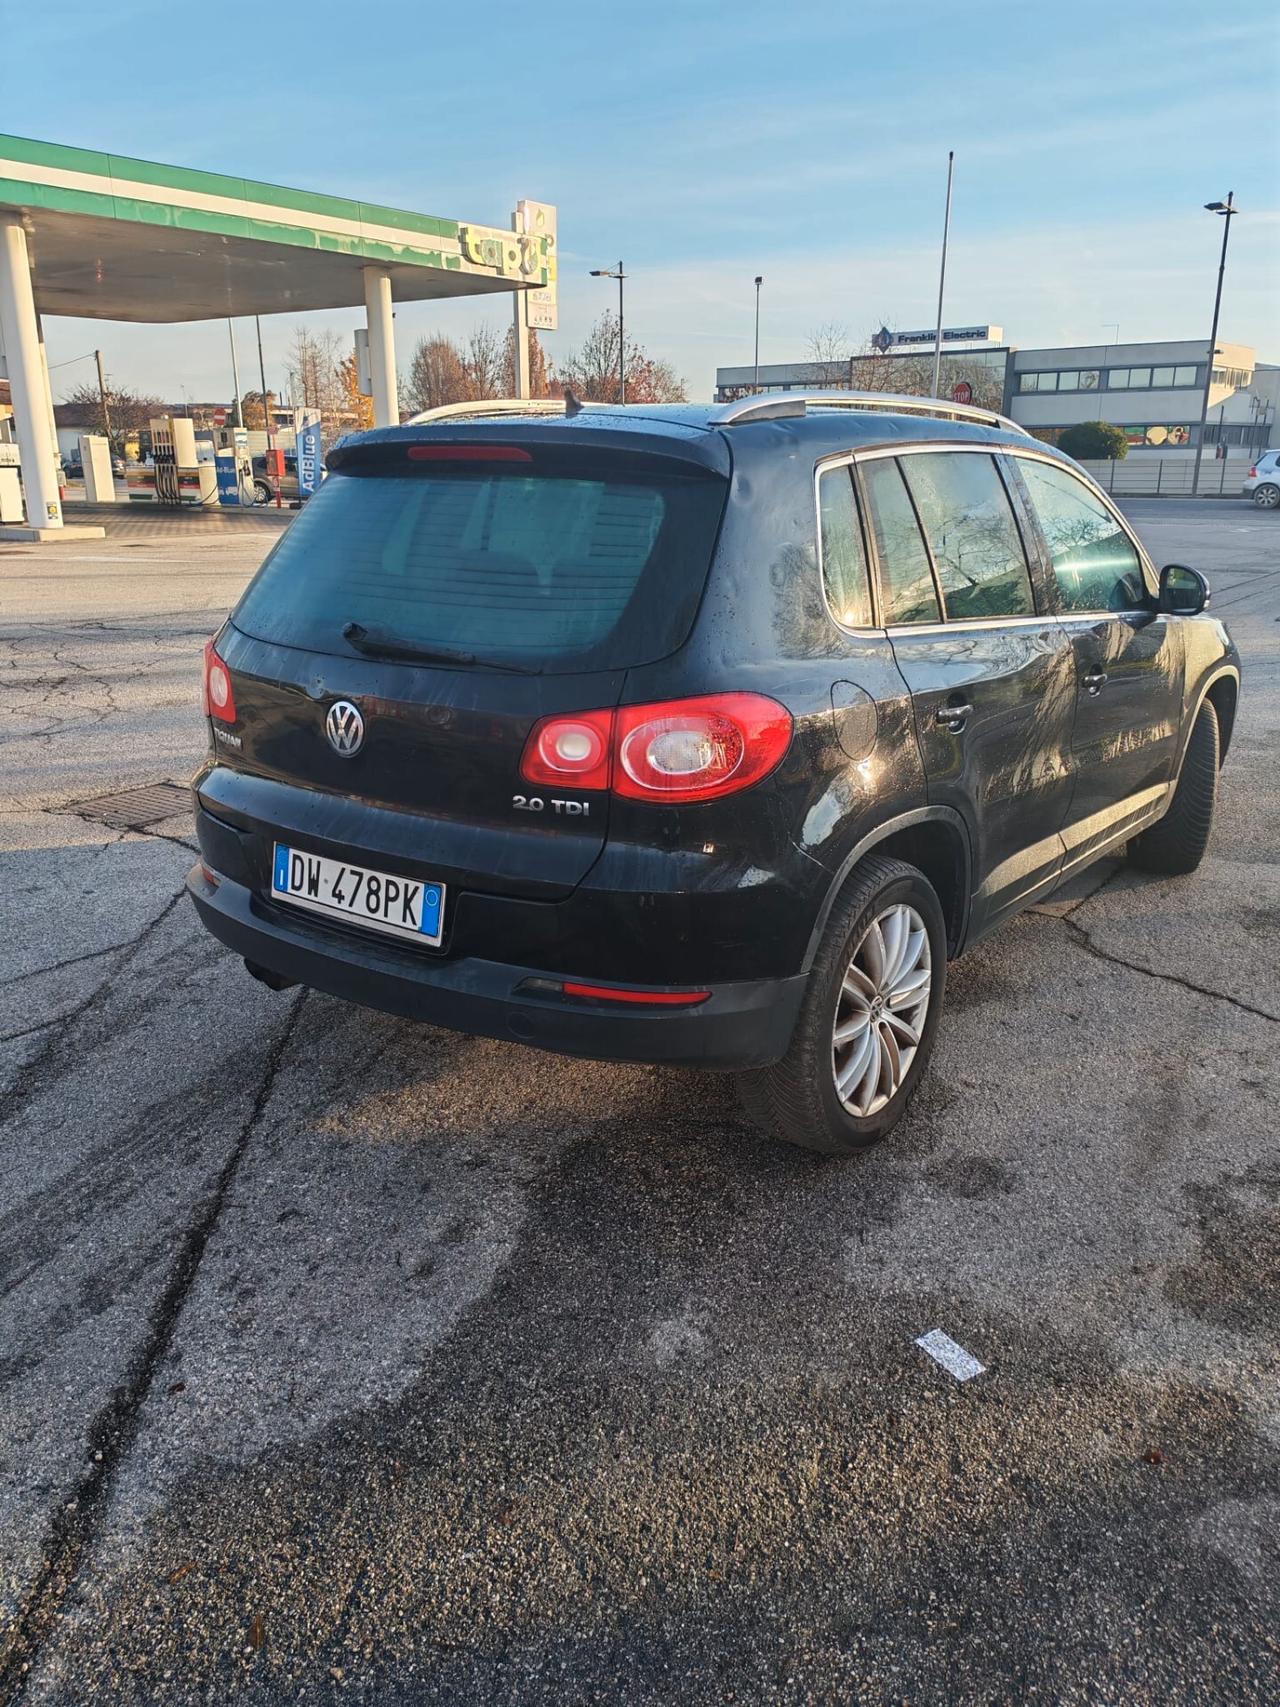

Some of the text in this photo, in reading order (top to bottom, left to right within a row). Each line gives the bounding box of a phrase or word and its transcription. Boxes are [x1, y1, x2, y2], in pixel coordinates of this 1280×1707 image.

[943, 330, 986, 340] Electric
[953, 391, 969, 402] STOP
[303, 434, 315, 492] AdBlue
[550, 799, 590, 816] TDI
